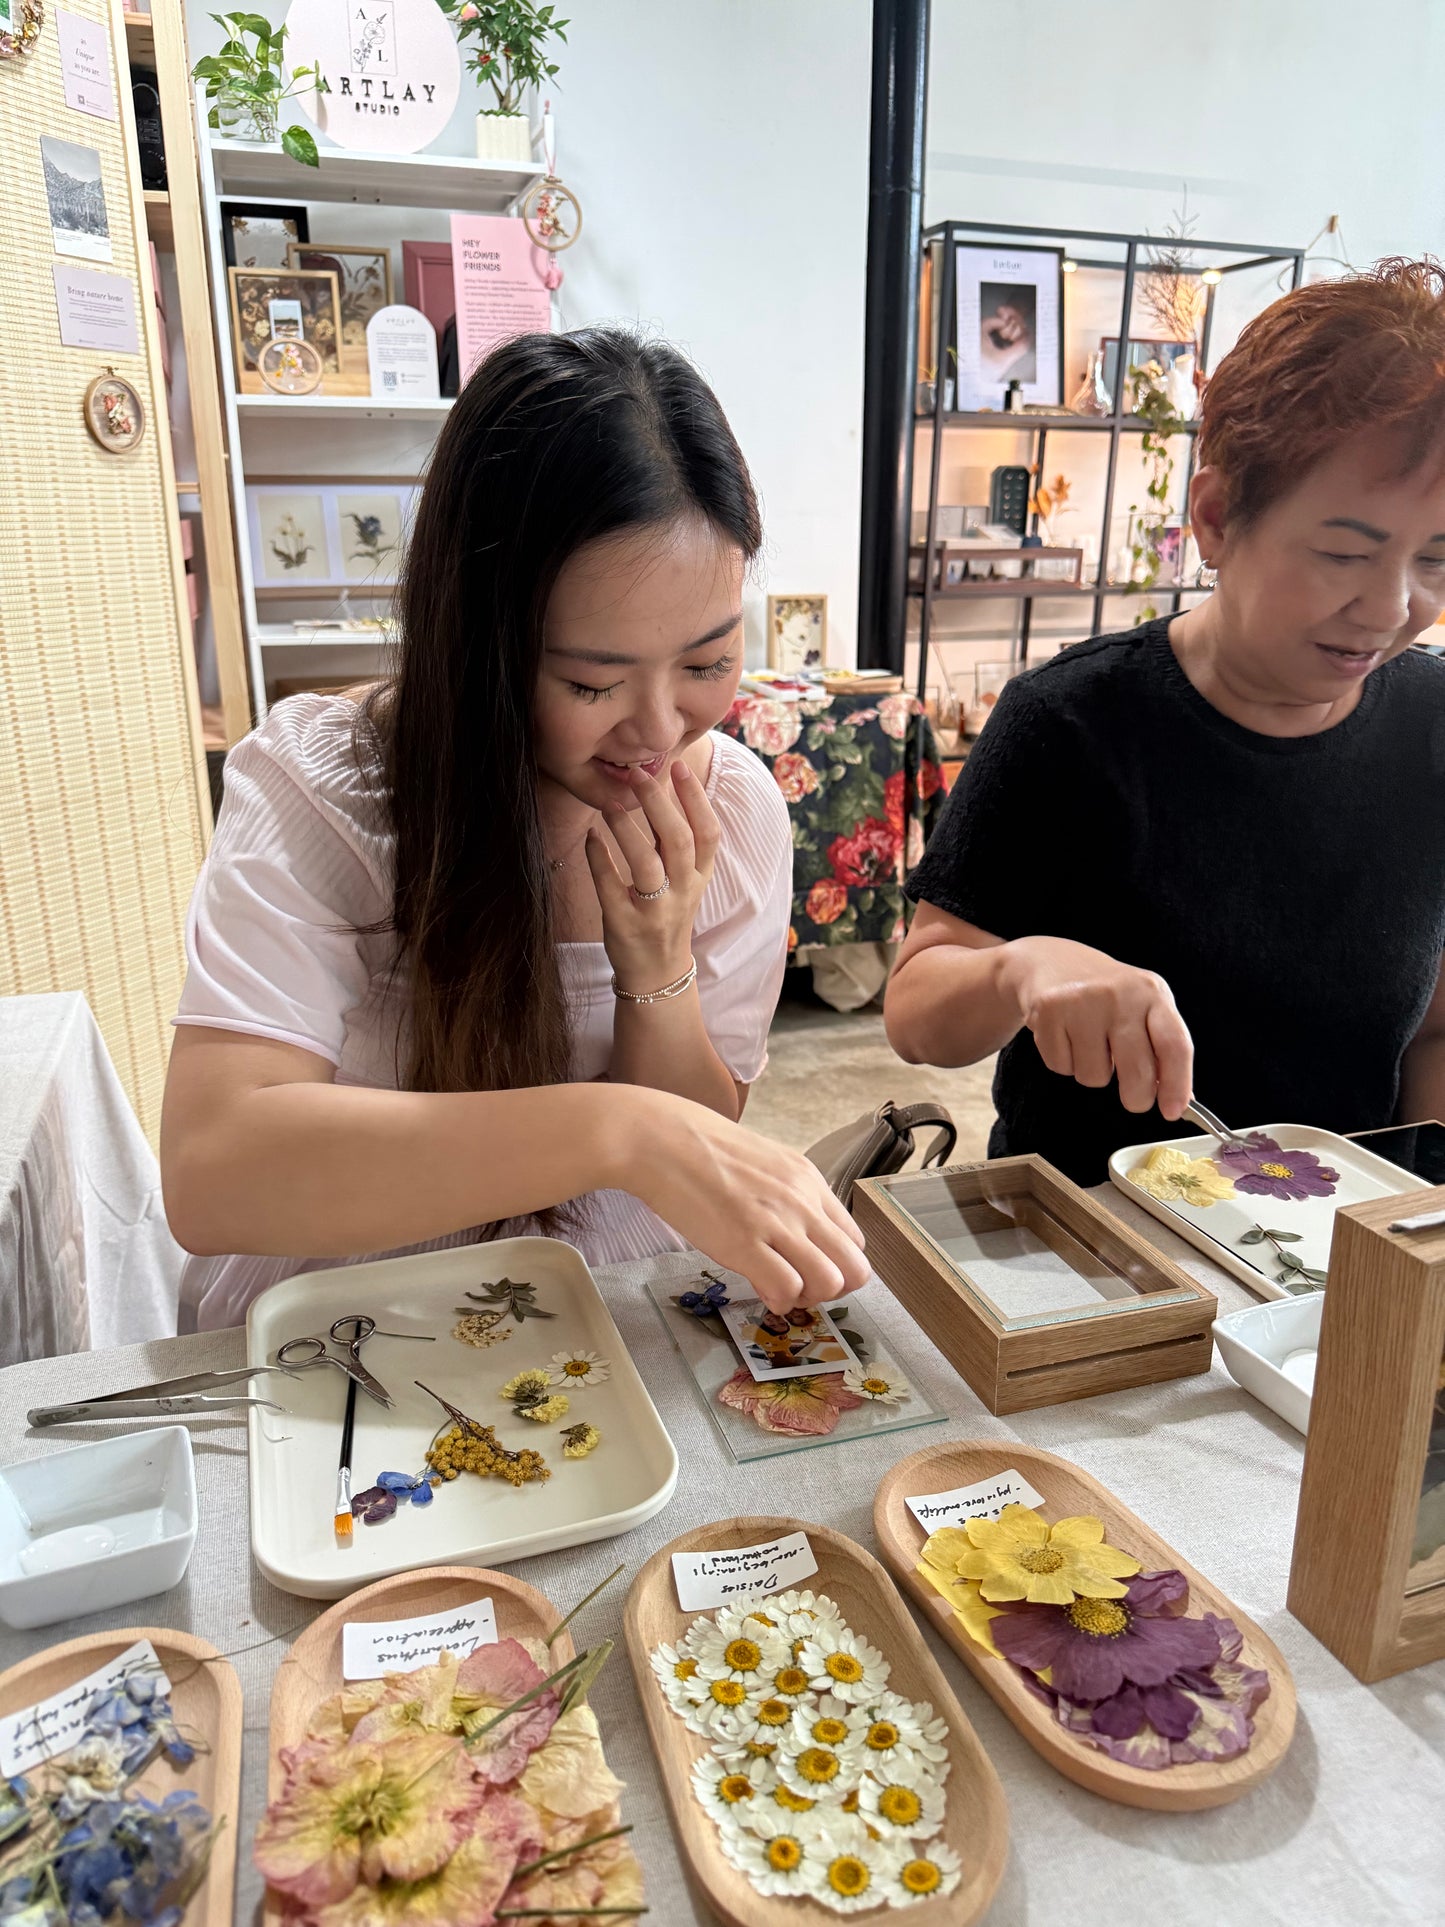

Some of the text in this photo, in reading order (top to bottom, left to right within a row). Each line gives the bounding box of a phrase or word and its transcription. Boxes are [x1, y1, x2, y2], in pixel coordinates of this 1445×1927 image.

[356, 8, 367, 20] A
[75, 48, 95, 61] Unique
[378, 49, 389, 62] L
[318, 75, 436, 103] ARTLAY
[355, 102, 400, 115] STUDIO
[462, 239, 480, 247] HEY
[463, 251, 500, 260] FLOWER
[463, 262, 501, 272] FRIENDS
[67, 286, 124, 302] Bring nature home
[961, 1496, 985, 1508] love
[711, 1545, 779, 1567] motherhood
[721, 1573, 778, 1594] Daisies
[372, 1618, 475, 1644] appreciation
